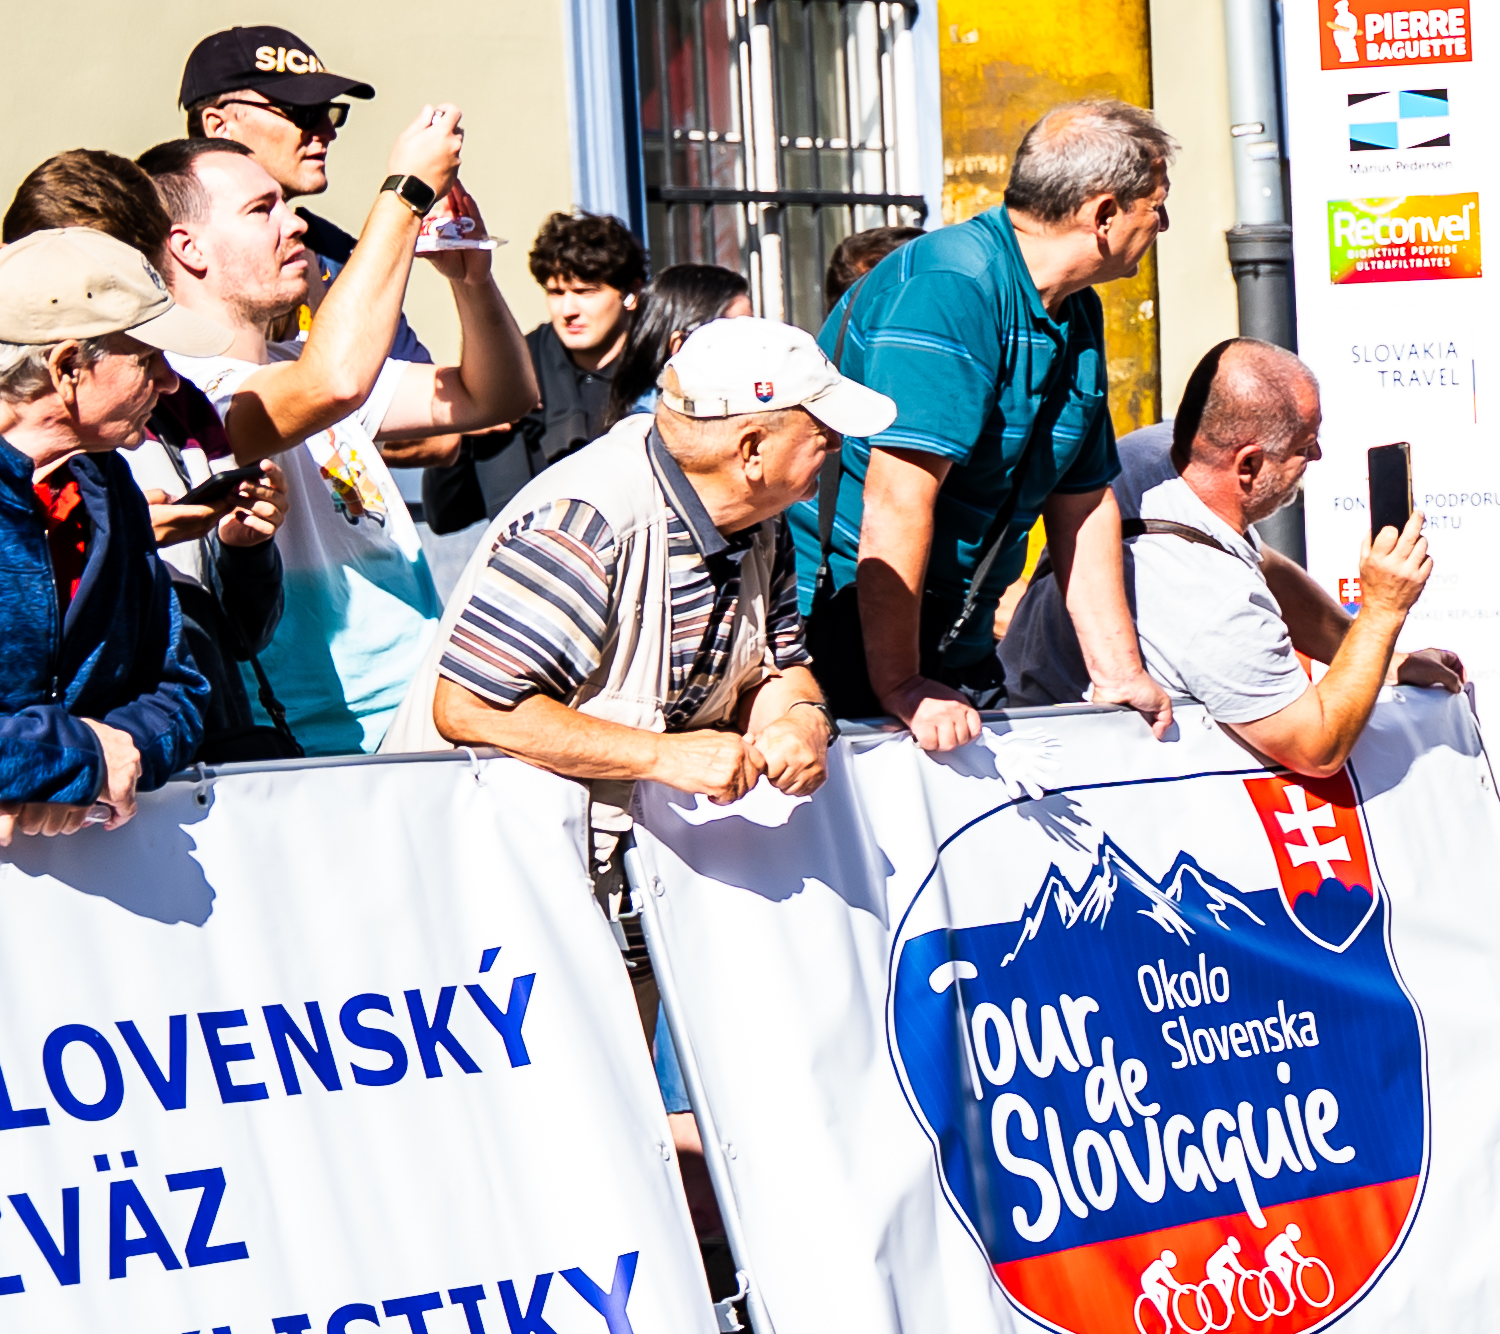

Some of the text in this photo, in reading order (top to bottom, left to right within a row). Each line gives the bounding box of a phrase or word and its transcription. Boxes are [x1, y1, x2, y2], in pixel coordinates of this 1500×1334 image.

[1364, 8, 1466, 44] PIERRE
[1366, 37, 1468, 62] BAGUETTE
[1351, 342, 1459, 365] SLOVAKIA
[1378, 368, 1461, 389] TRAVEL
[1334, 496, 1367, 511] FON
[1137, 953, 1231, 1013] Okolo
[0, 946, 537, 1133] LOVENSKÝ
[928, 959, 1100, 1101] Tour
[1161, 1000, 1320, 1071] Slovenska
[1085, 1037, 1161, 1126] de
[990, 1061, 1356, 1243] Slovaquie
[0, 1151, 250, 1297] VÄZ
